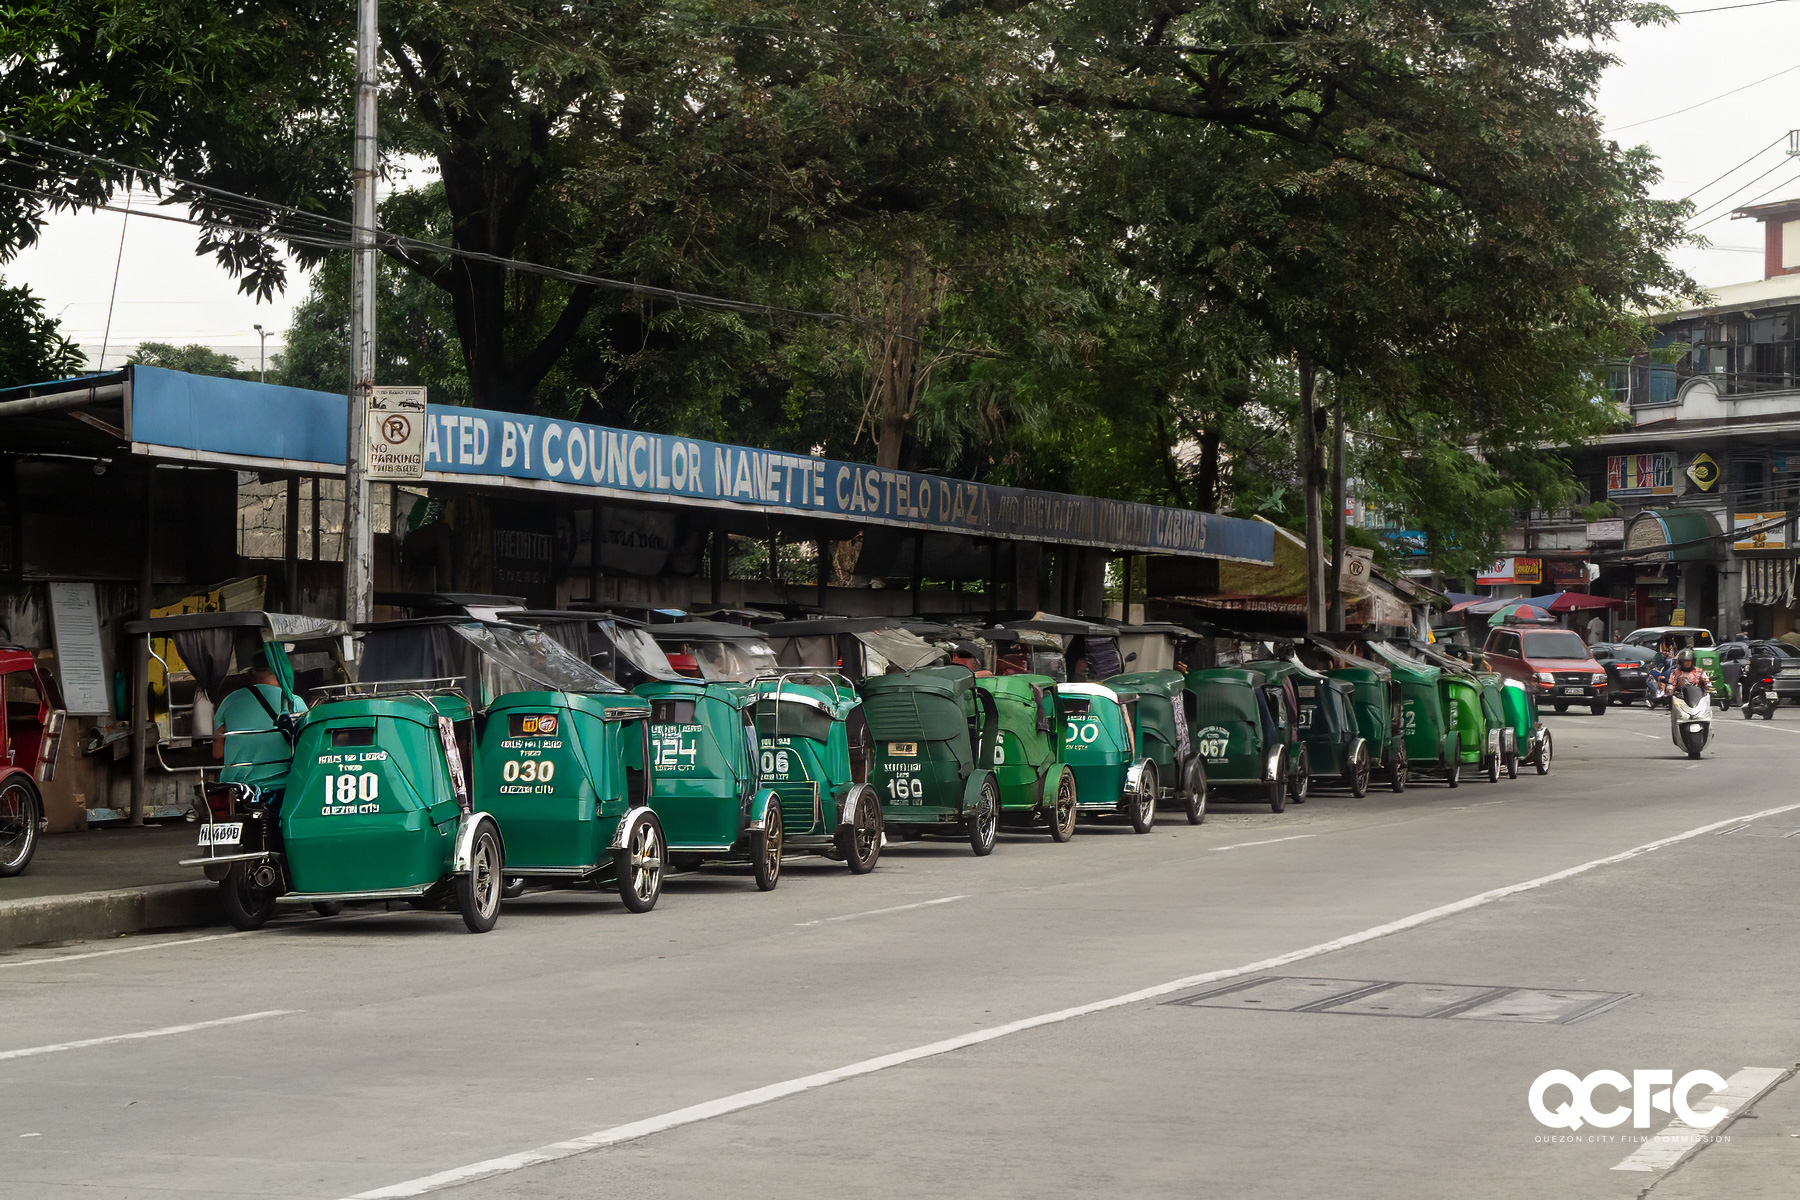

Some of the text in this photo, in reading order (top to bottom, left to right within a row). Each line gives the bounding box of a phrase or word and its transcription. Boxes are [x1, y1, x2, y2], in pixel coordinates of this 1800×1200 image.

[371, 443, 388, 453] NO
[371, 453, 421, 464] PARKING
[501, 421, 534, 470] BY
[542, 423, 704, 493] COUNCILOR
[714, 446, 826, 507] NANETTE
[836, 464, 932, 520] CASTELO
[652, 738, 697, 765] 124
[1200, 738, 1229, 758] 067
[503, 759, 555, 782] 030
[325, 771, 379, 805] 180
[886, 778, 923, 799] 160
